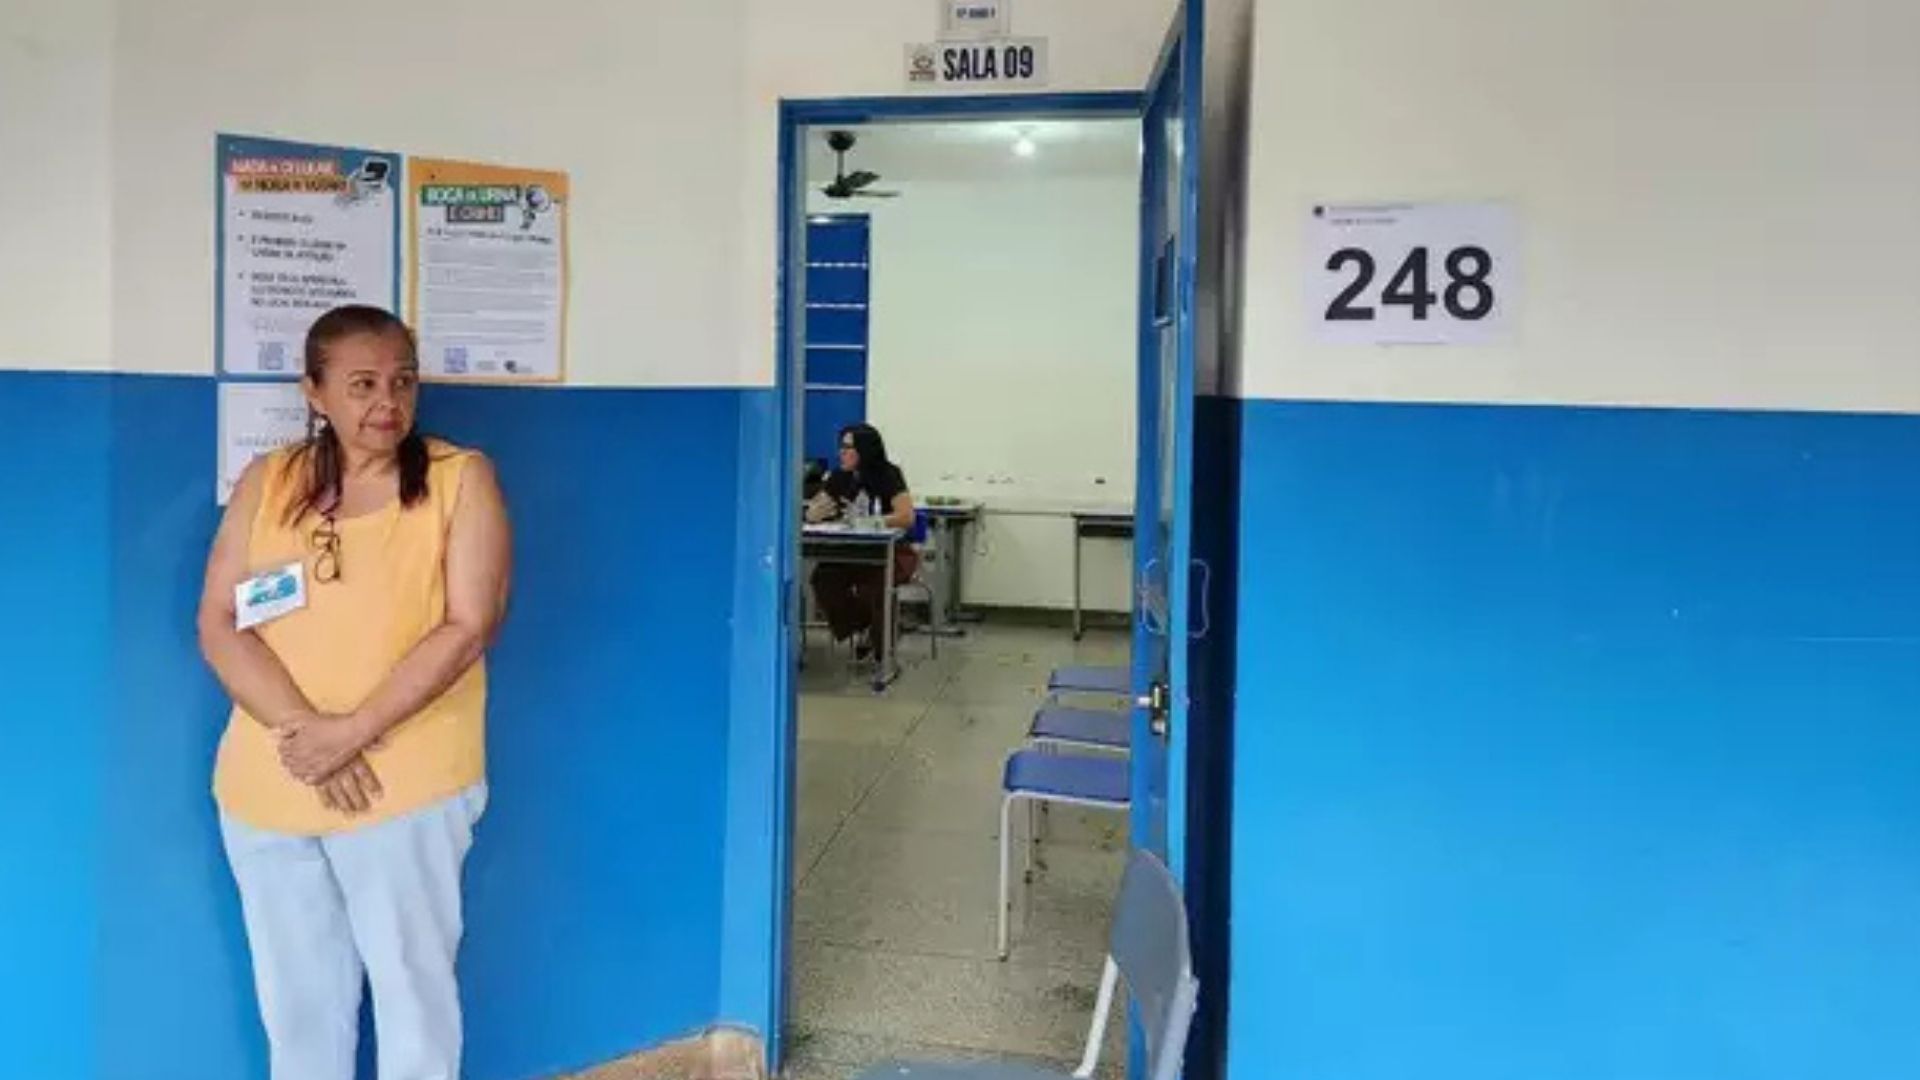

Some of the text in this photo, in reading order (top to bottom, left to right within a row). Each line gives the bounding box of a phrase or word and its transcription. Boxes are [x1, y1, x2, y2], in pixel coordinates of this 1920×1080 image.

[943, 45, 1034, 81] SALA 09
[1325, 247, 1494, 320] 248
